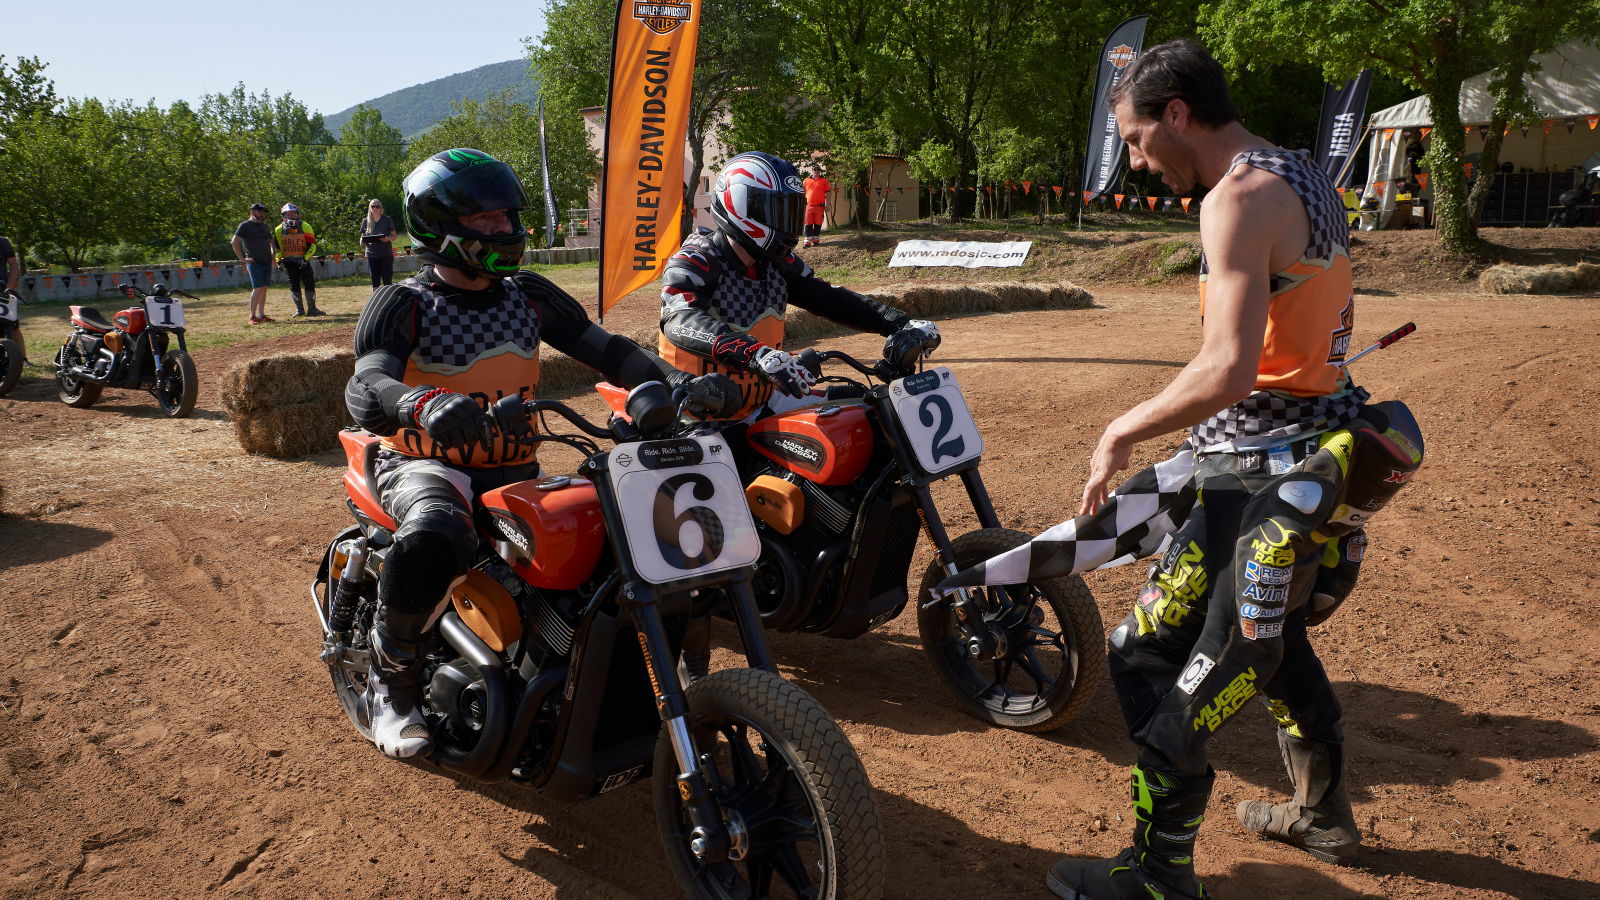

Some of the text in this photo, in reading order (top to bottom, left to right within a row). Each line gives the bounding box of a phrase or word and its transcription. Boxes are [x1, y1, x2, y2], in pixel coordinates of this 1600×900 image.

[638, 5, 688, 17] HARLEY-DAVIDSON
[648, 18, 677, 30] CYCLES
[1328, 112, 1355, 157] MEDIA
[1100, 166, 1109, 178] FOR
[160, 304, 175, 325] 1
[918, 394, 965, 465] 2
[644, 449, 661, 457] Ride.
[662, 447, 678, 455] Ride.
[774, 440, 818, 461] DAVIDSON
[652, 472, 725, 570] 6
[637, 631, 663, 697] Continental
[1193, 666, 1258, 732] MUGEN
[1206, 682, 1258, 733] RACE
